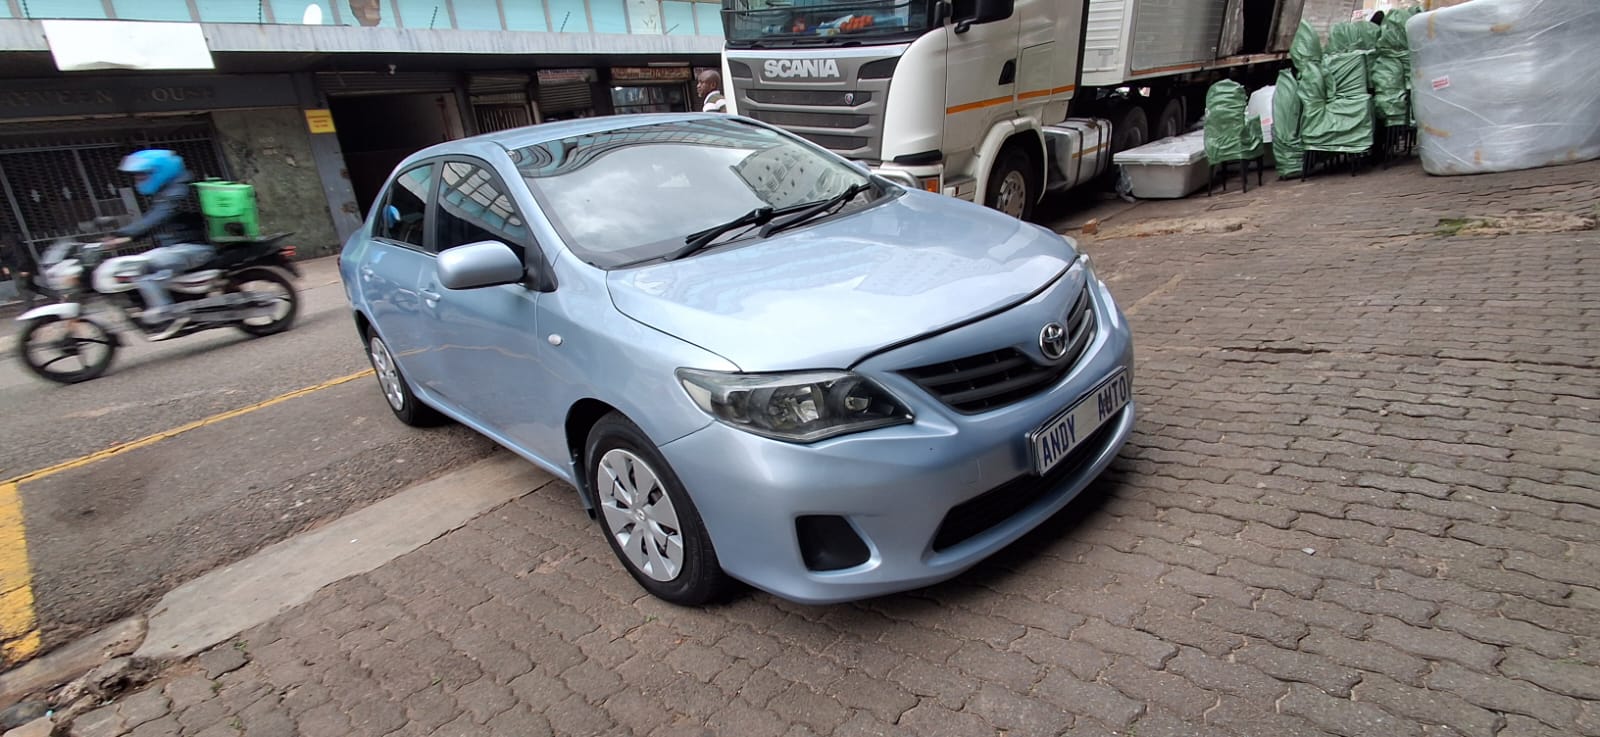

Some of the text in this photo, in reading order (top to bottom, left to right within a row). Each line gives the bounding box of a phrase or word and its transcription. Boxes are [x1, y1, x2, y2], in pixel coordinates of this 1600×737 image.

[764, 59, 840, 78] SCANIA
[131, 87, 214, 103] OUSE
[1042, 375, 1127, 467] ANDY AUTO
